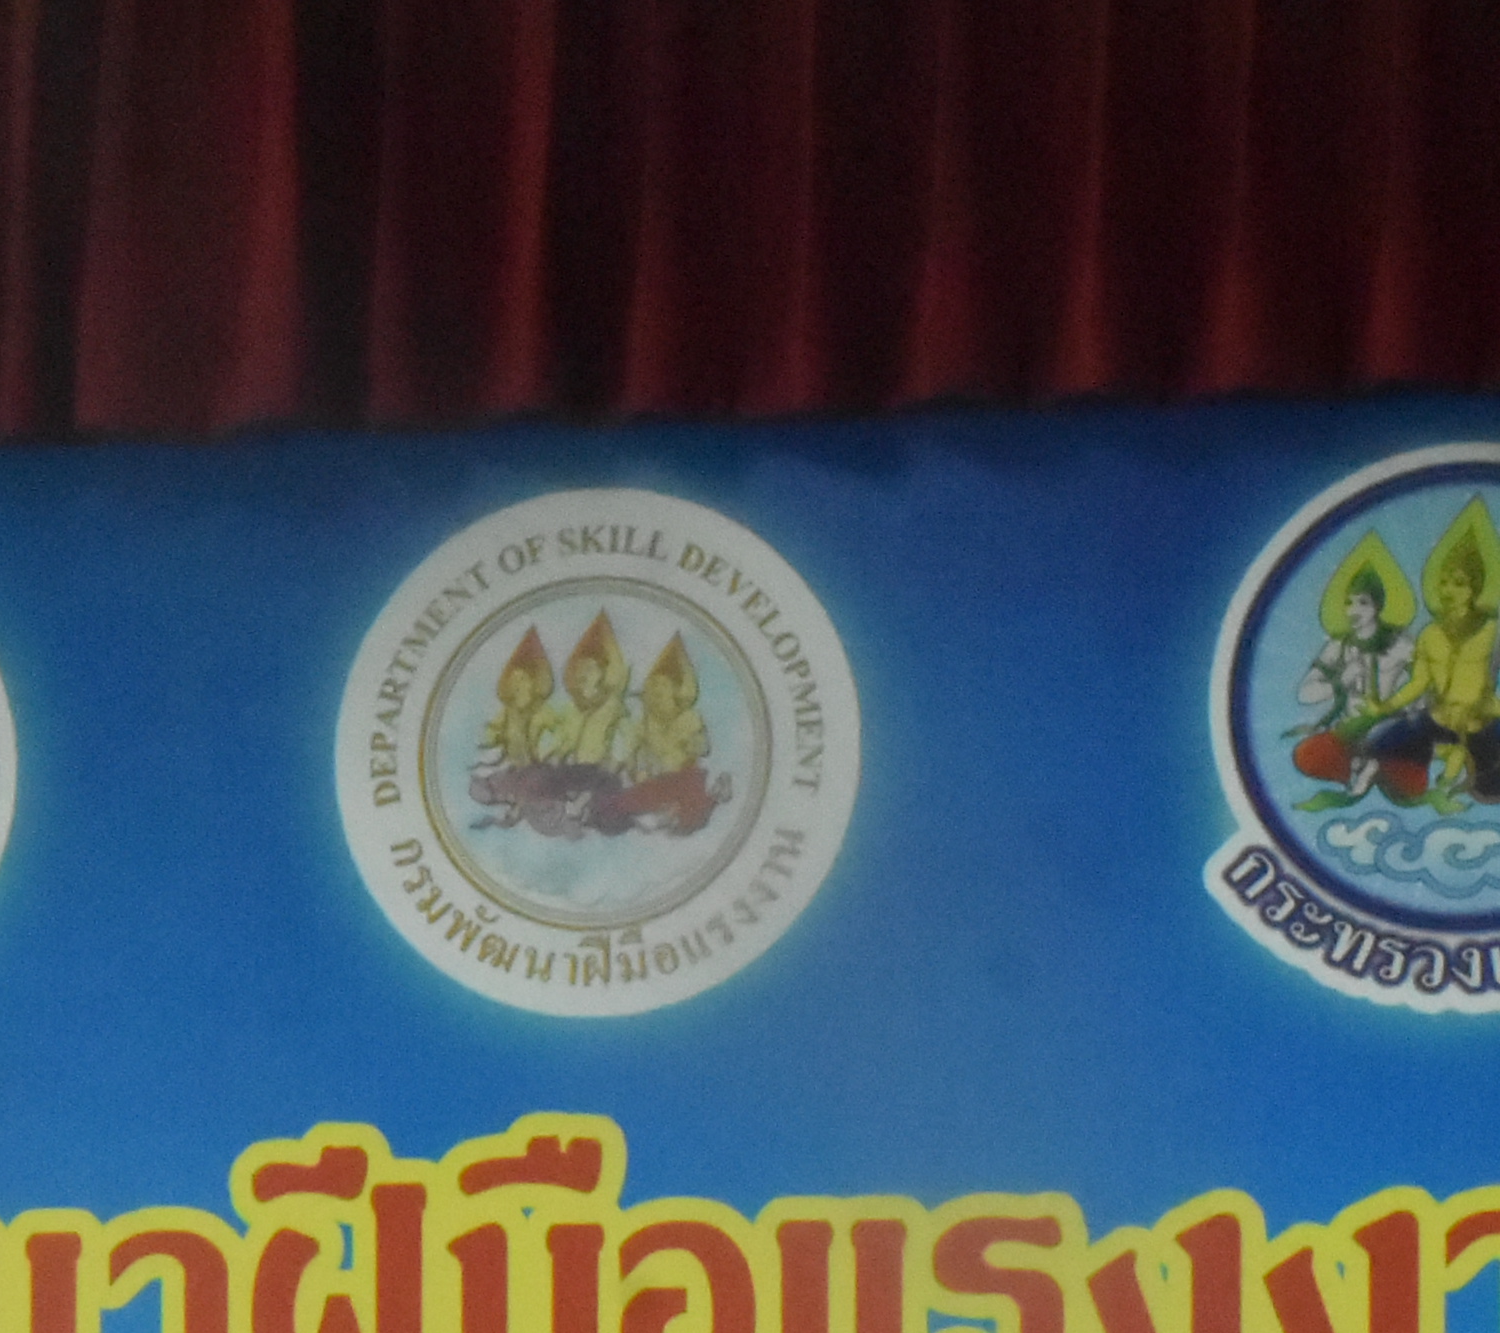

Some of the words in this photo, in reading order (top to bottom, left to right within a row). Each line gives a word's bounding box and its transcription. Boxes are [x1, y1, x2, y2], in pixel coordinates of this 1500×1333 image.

[369, 560, 500, 808] DEPARTMENT
[496, 532, 546, 577] OF
[556, 524, 670, 564] SKILL
[675, 543, 825, 794] DEVELOPMENT
[1222, 843, 1500, 994] กระทรวง
